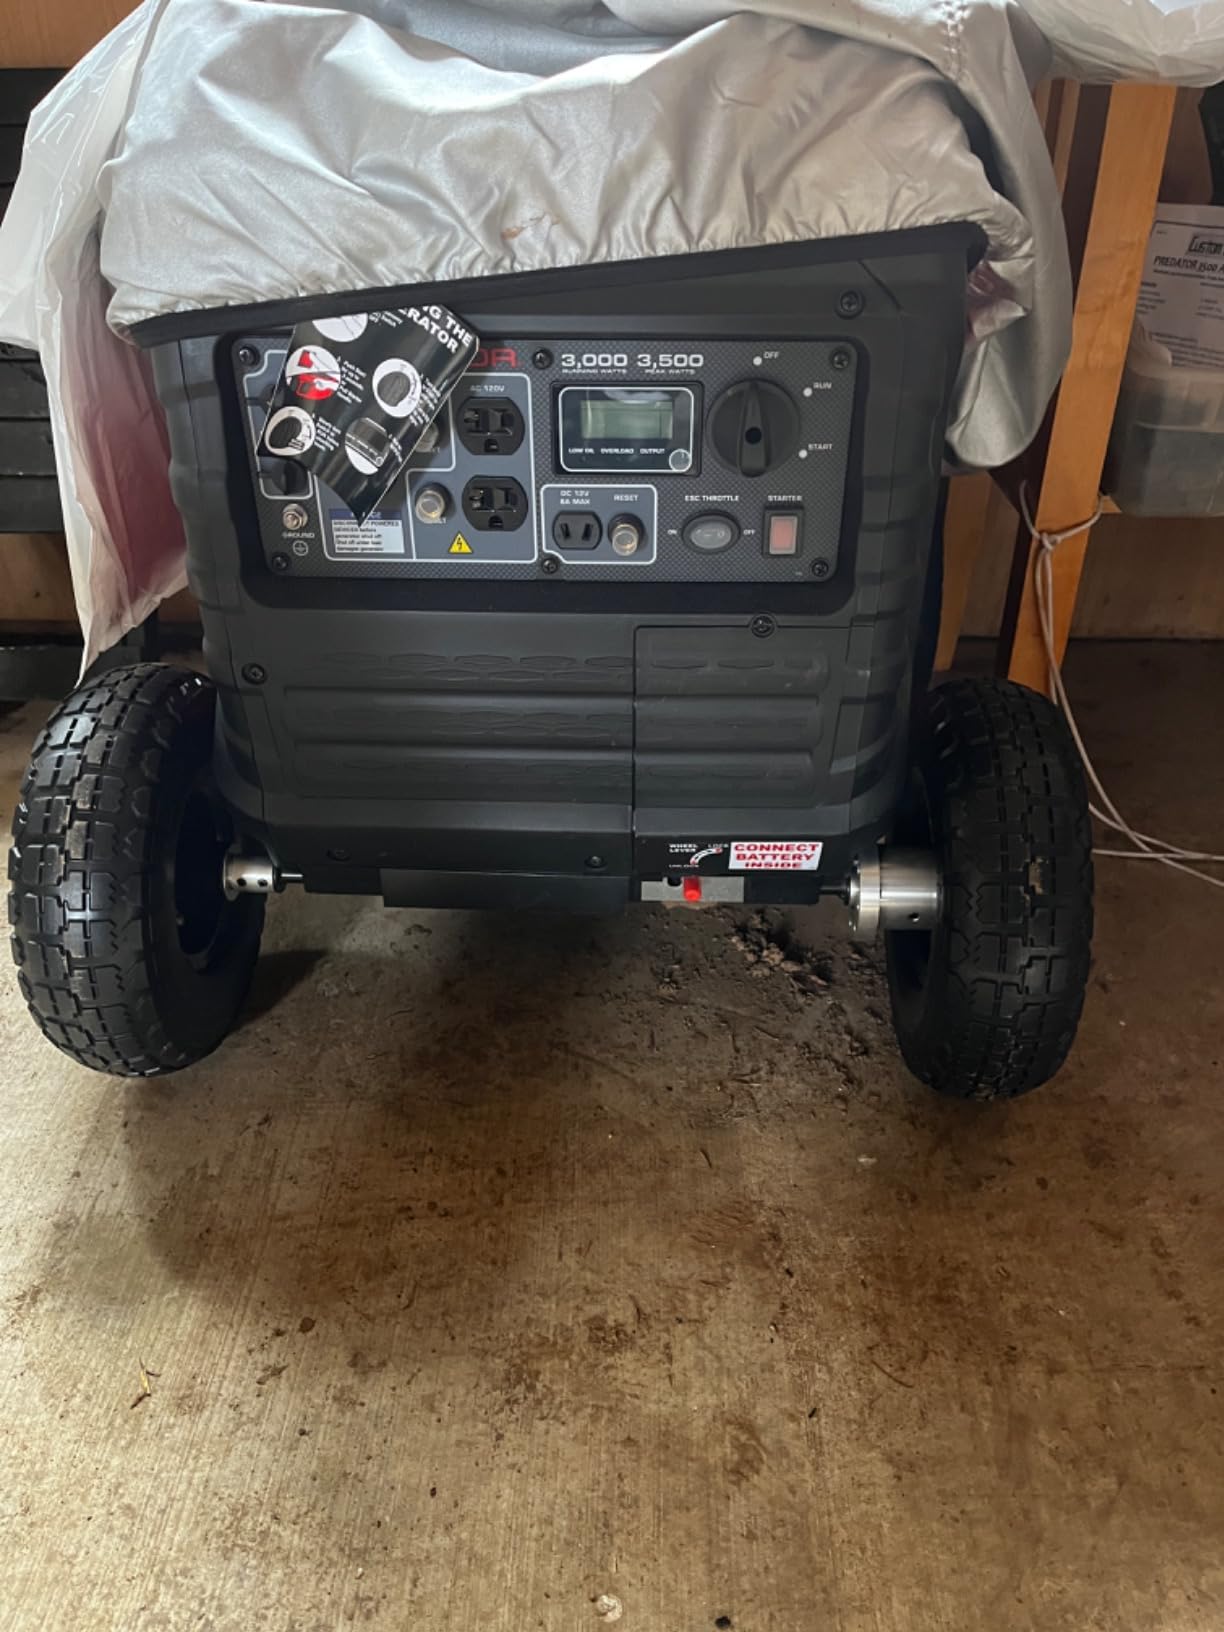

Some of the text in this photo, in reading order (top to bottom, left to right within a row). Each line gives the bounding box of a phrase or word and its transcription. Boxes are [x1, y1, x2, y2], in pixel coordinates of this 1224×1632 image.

[1153, 255, 1198, 270] PREDATOR
[445, 315, 473, 347] THE
[763, 351, 779, 359] OFF
[561, 353, 704, 369] 3,000 3,500
[734, 844, 820, 852] CONNECT
[736, 853, 815, 861] BATTERY
